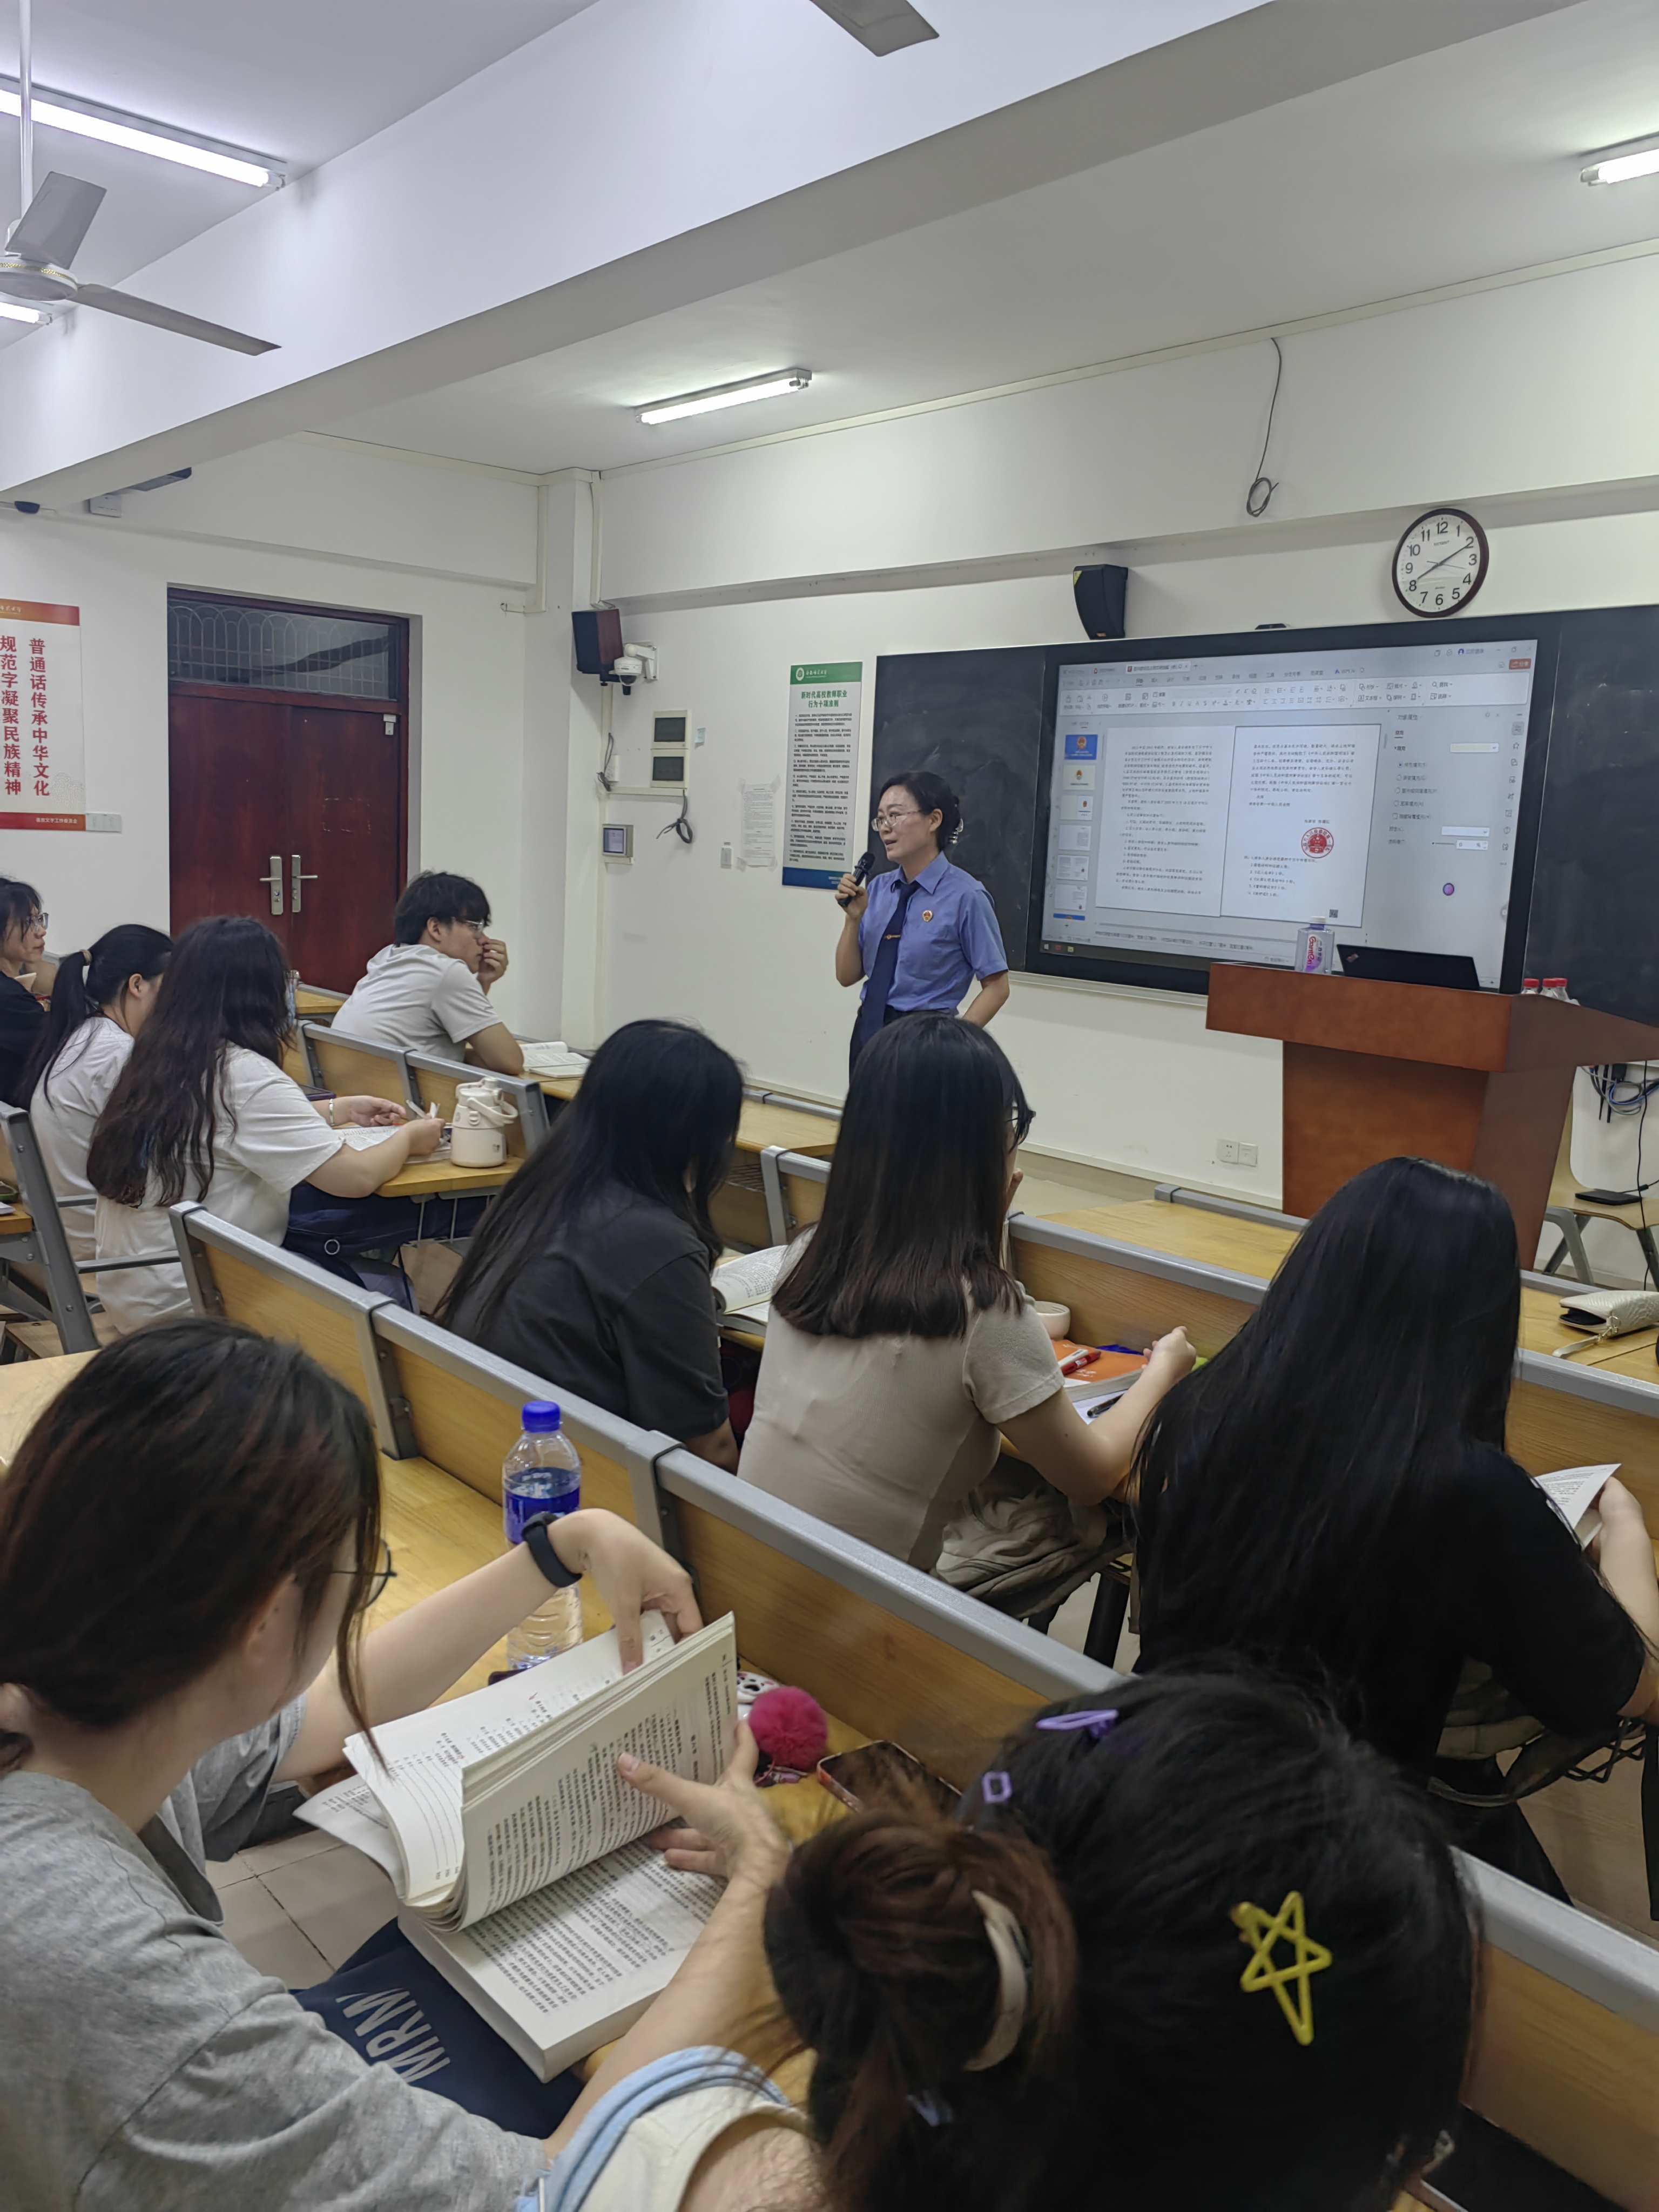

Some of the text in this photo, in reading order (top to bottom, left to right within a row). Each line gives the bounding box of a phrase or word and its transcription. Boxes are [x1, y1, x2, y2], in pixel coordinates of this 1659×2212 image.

[1437, 522, 1448, 534] 12
[1456, 524, 1460, 537] 1
[1421, 529, 1430, 542] 11
[1465, 536, 1474, 549] 2
[1409, 544, 1421, 557] 10
[1468, 554, 1477, 566] 3
[1405, 562, 1413, 574] 9
[1462, 572, 1472, 585] 4
[1409, 580, 1417, 591] 8
[1420, 591, 1428, 604] 7
[1435, 594, 1444, 605] 6
[1452, 588, 1460, 599] 5
[801, 690, 847, 699] 新时代高校教师职业
[808, 700, 839, 708] 行为十项准则
[0, 635, 22, 796] 规范字凝聚民族精神
[29, 638, 50, 797] 普通话传承中华文化
